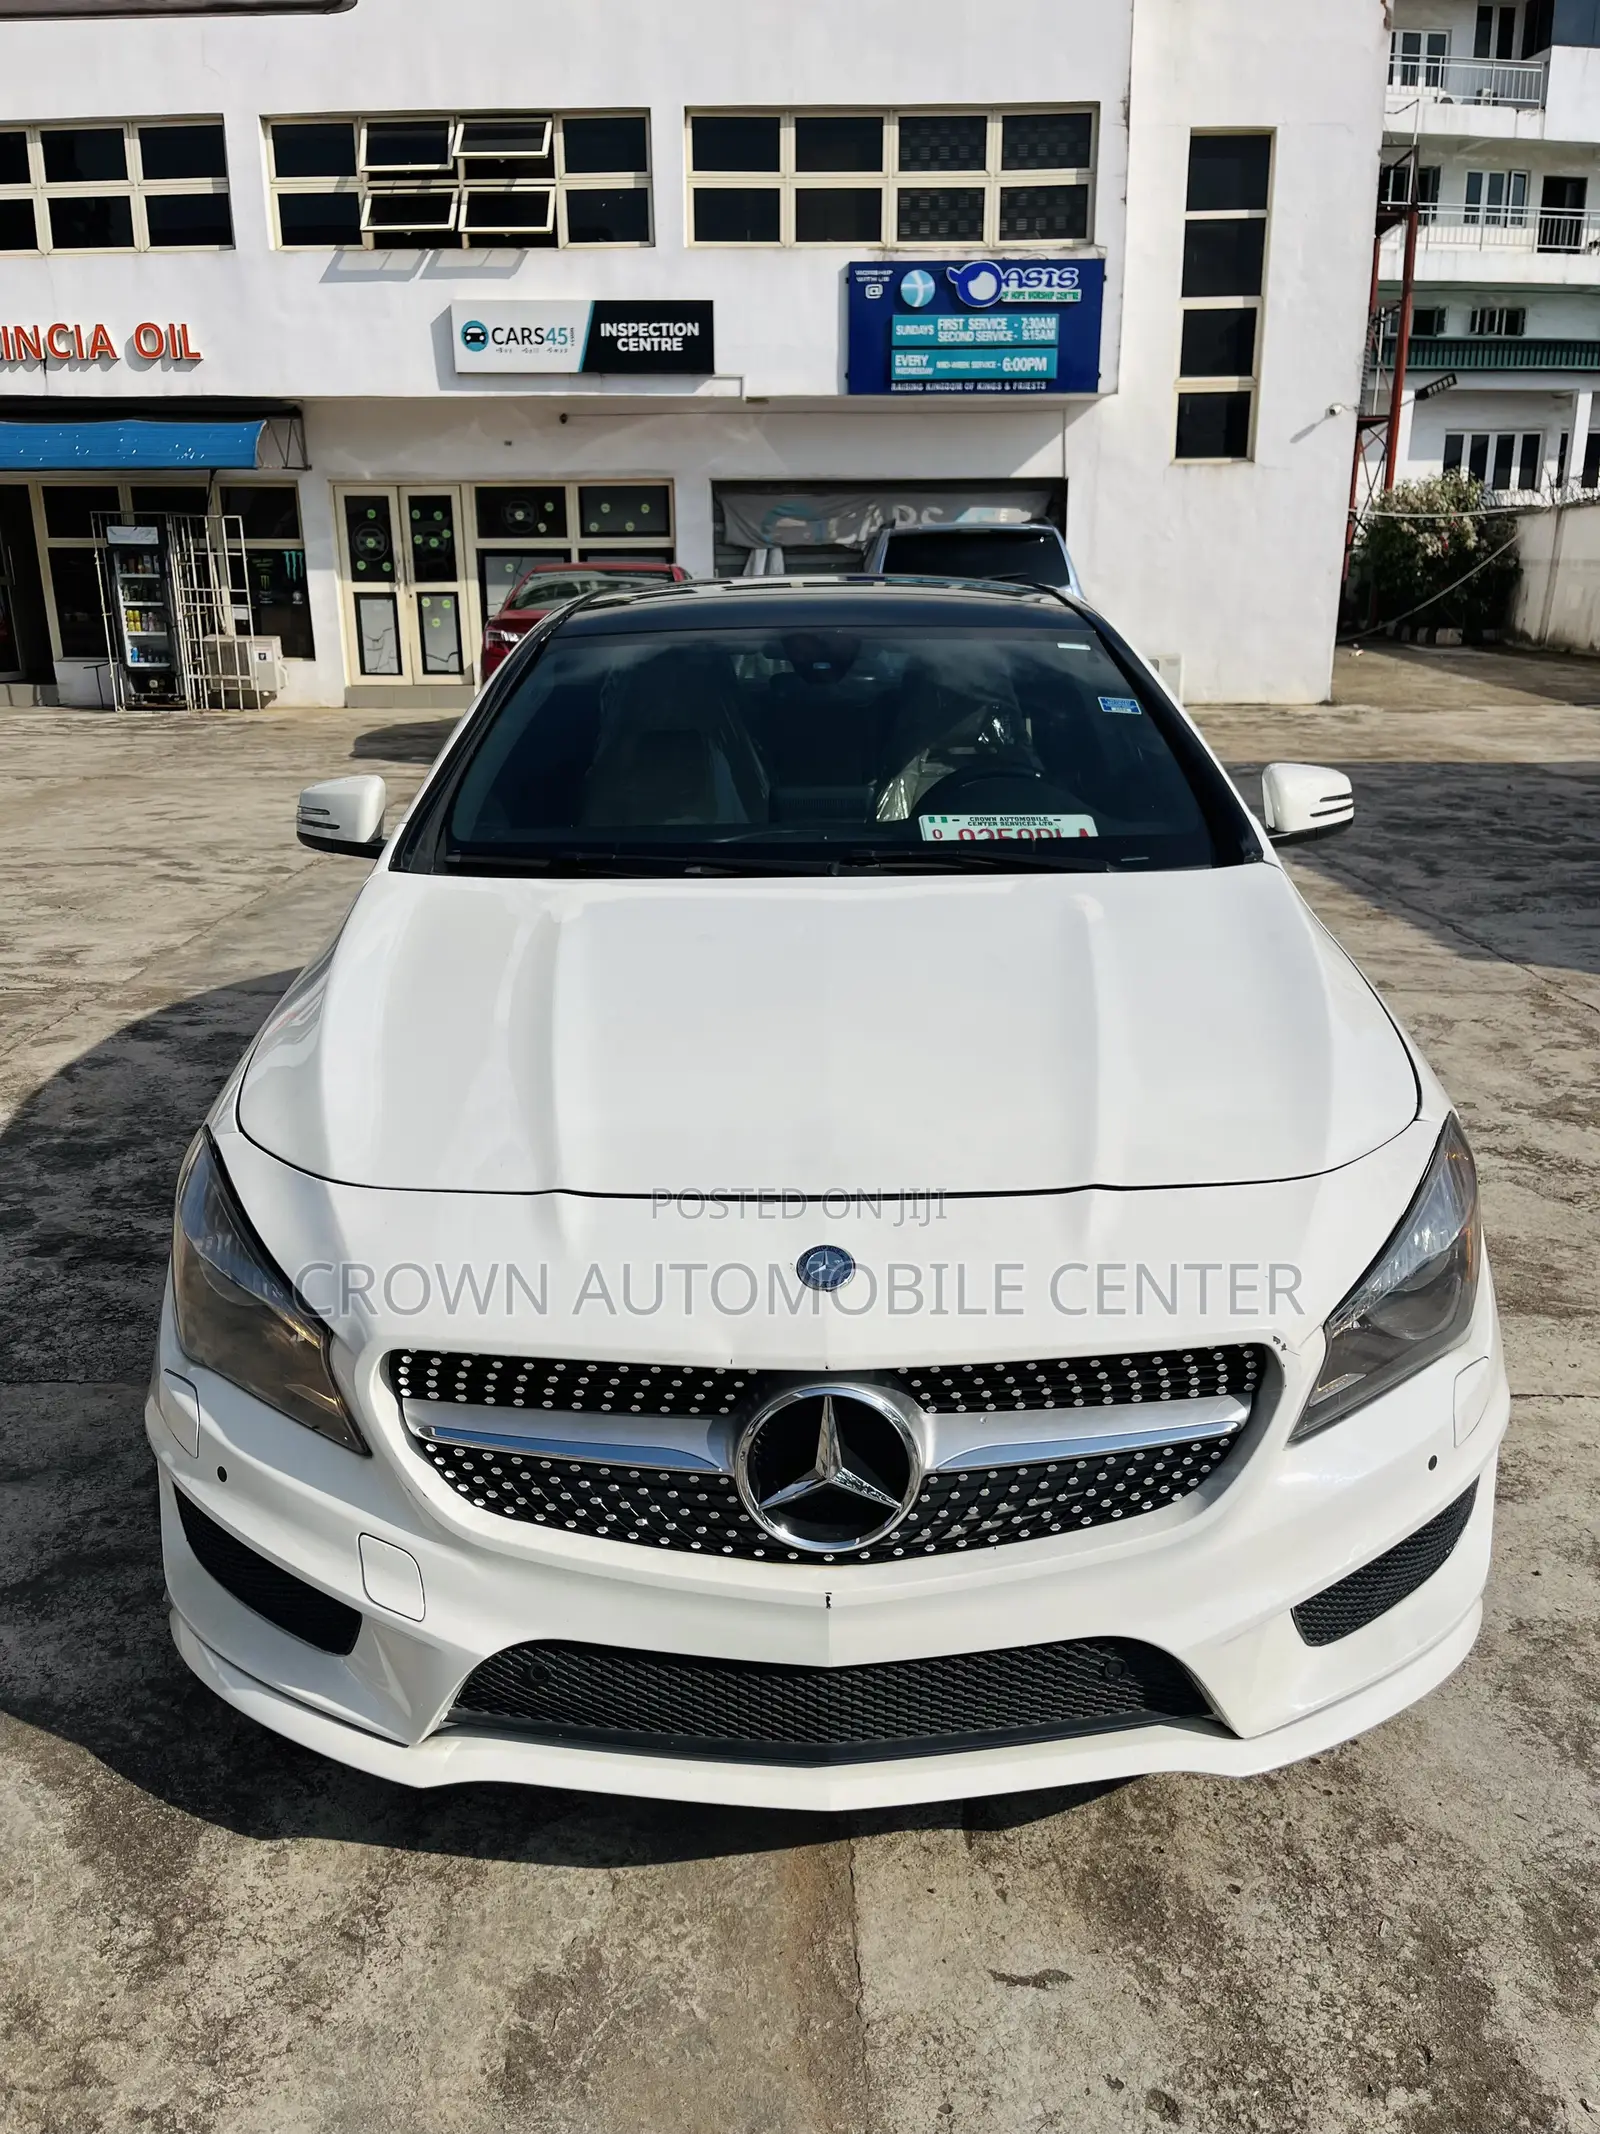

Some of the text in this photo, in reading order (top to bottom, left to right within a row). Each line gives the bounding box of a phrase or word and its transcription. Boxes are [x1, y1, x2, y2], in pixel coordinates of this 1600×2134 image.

[946, 261, 1079, 309] OASIS
[600, 322, 699, 337] INSPECTION
[896, 324, 934, 336] SUNDAYS
[937, 318, 965, 330] FIRST
[968, 318, 1007, 330] SERVICE
[1021, 317, 1056, 330] 7:30AM
[1, 322, 203, 360] INCIA OIL
[491, 326, 568, 346] CARS45
[937, 331, 974, 342] SECOND
[975, 330, 1013, 342] SERVICE
[1022, 329, 1056, 341] 9:15AM
[617, 337, 683, 351] CENTRE
[895, 354, 929, 367] EVERY
[1002, 357, 1047, 372] 6:00PM
[964, 382, 975, 391] OF
